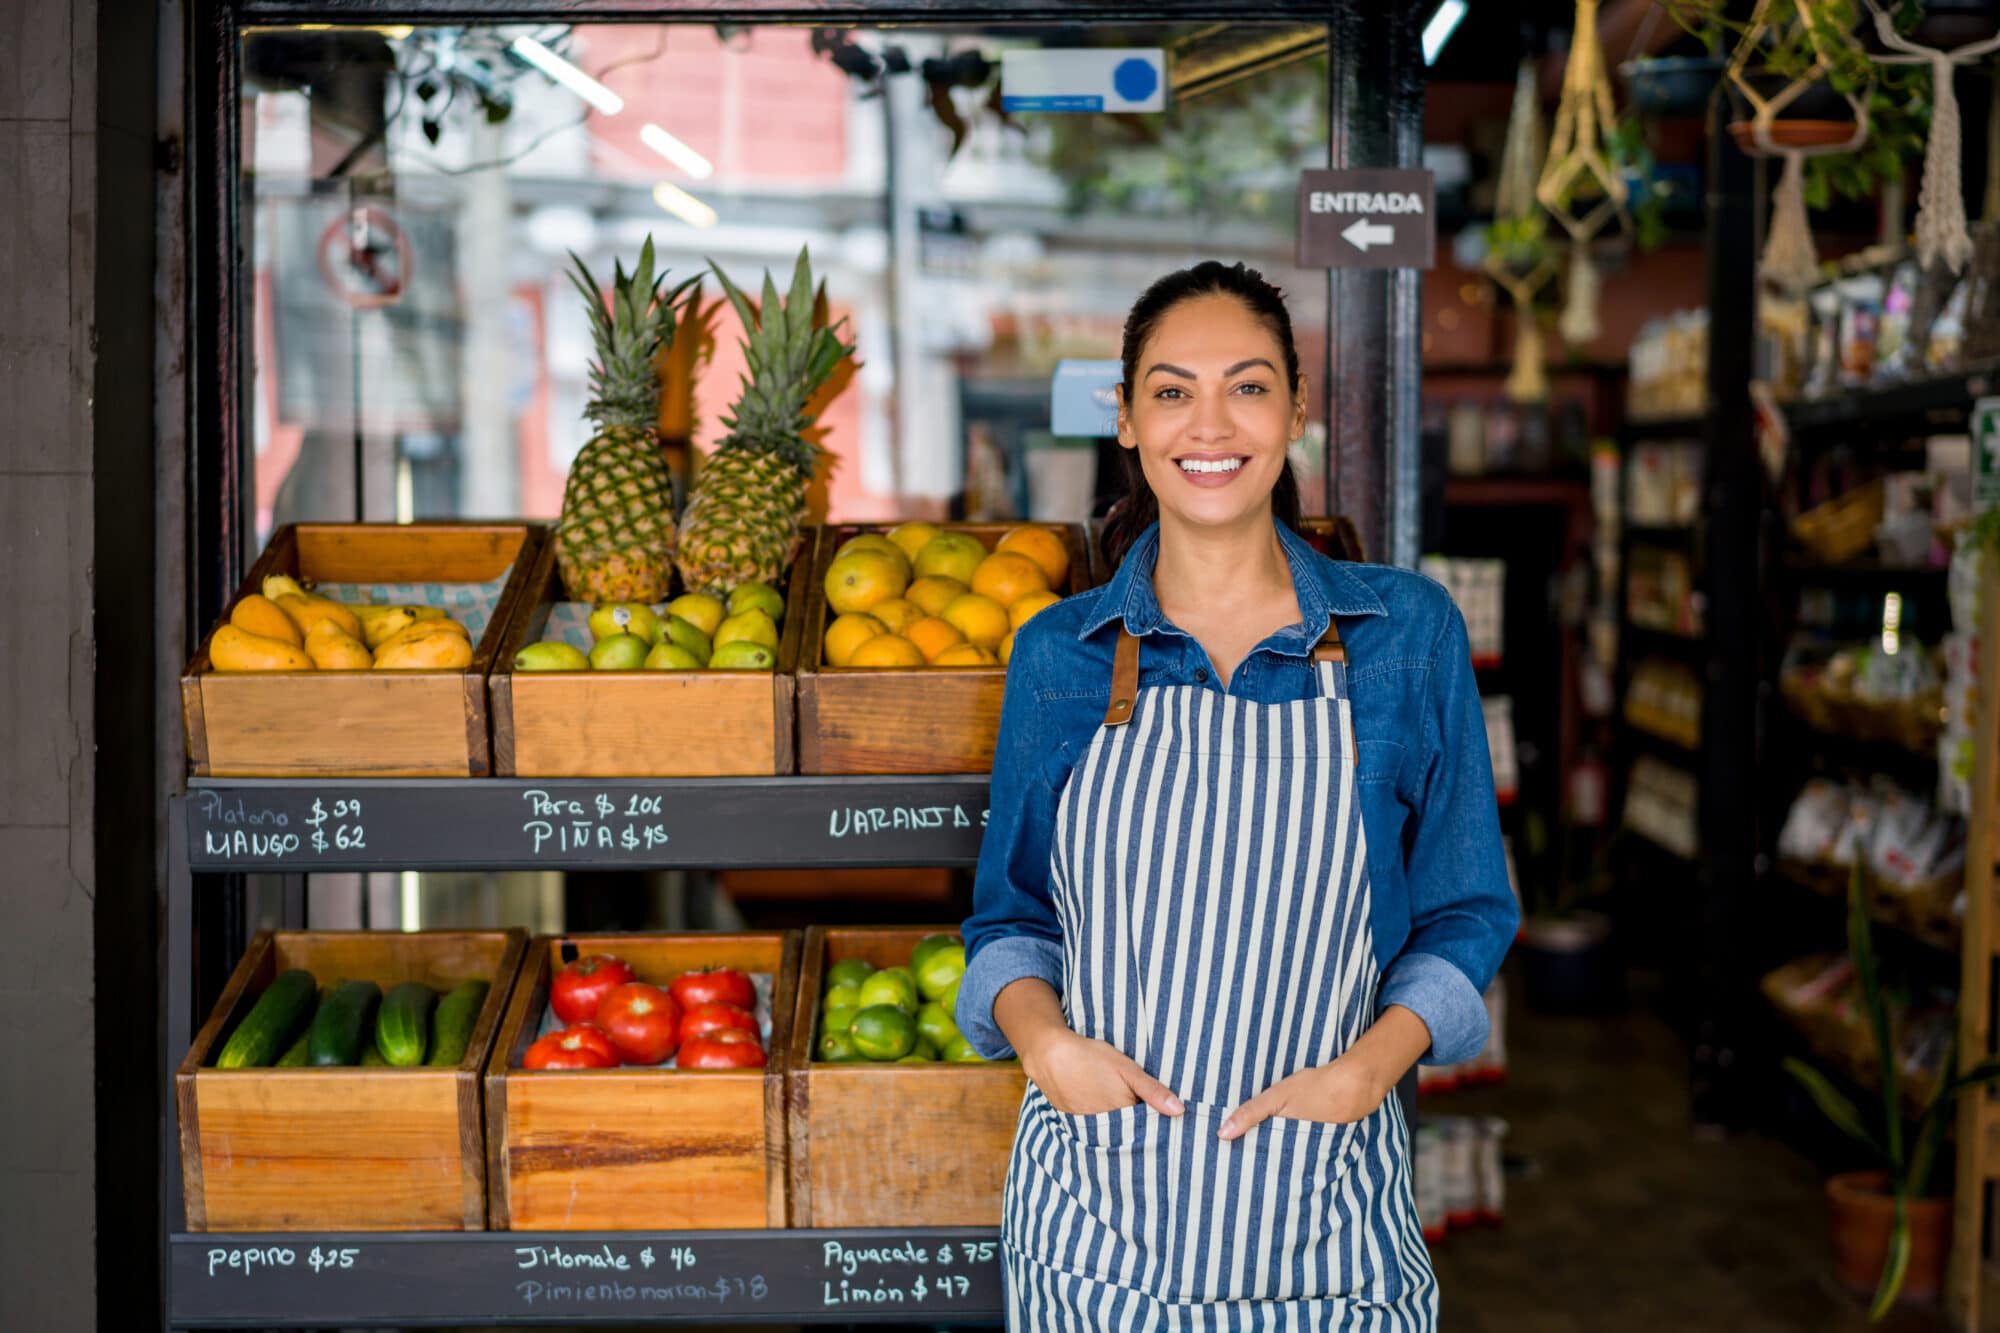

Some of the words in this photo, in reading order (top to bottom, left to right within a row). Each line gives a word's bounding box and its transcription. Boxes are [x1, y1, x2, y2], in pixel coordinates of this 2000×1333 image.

[1309, 191, 1424, 213] ENTRADA
[198, 789, 288, 826] Platano
[523, 790, 584, 816] Pera
[206, 829, 299, 858] MANGO
[523, 820, 613, 853] PIÑA
[515, 1245, 631, 1270] Jitomate
[823, 1240, 928, 1275] Aguacate
[824, 1279, 904, 1305] Limón
